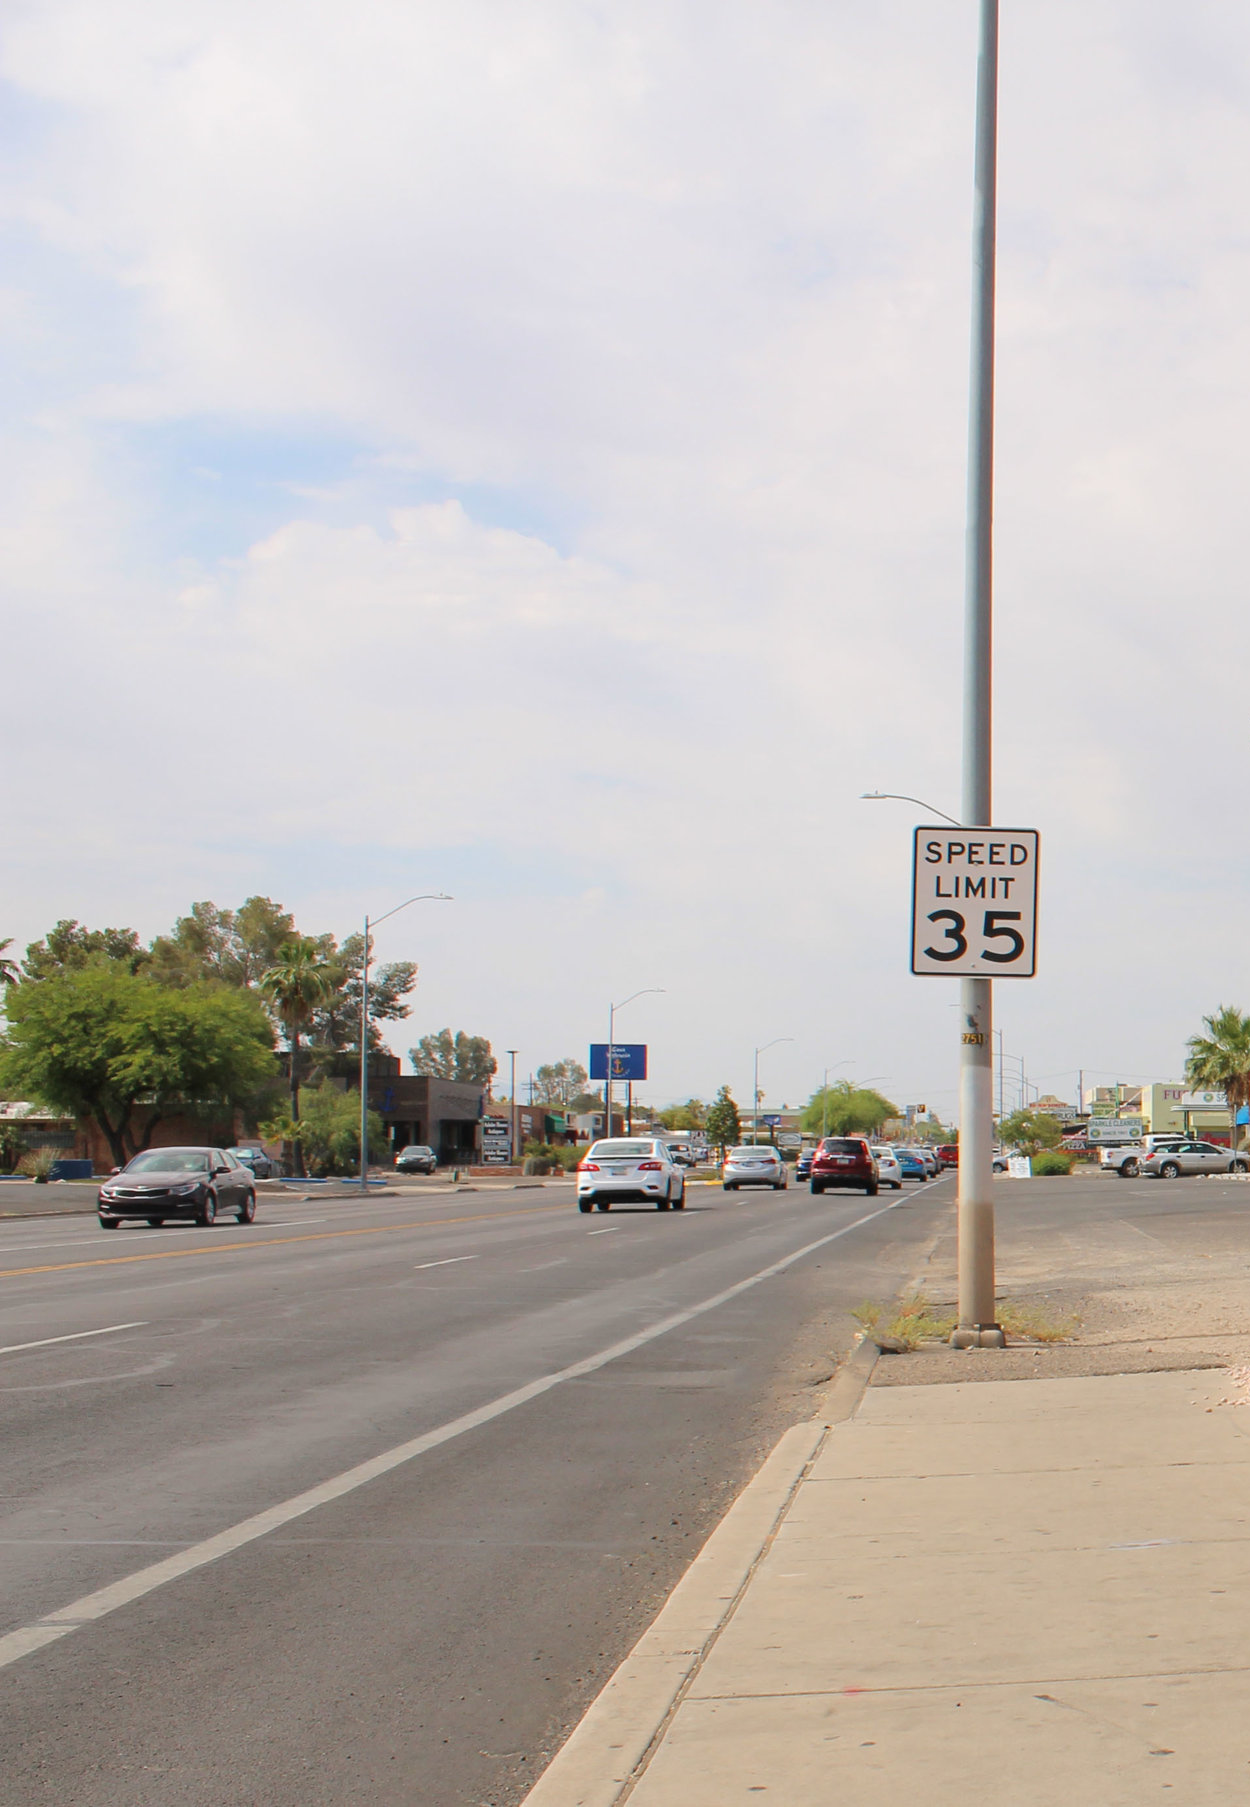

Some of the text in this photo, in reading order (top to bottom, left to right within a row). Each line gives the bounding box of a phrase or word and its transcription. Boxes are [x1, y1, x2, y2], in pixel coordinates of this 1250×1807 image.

[924, 841, 1028, 866] SPEED
[935, 875, 1015, 899] LIMIT
[923, 909, 1025, 964] 35
